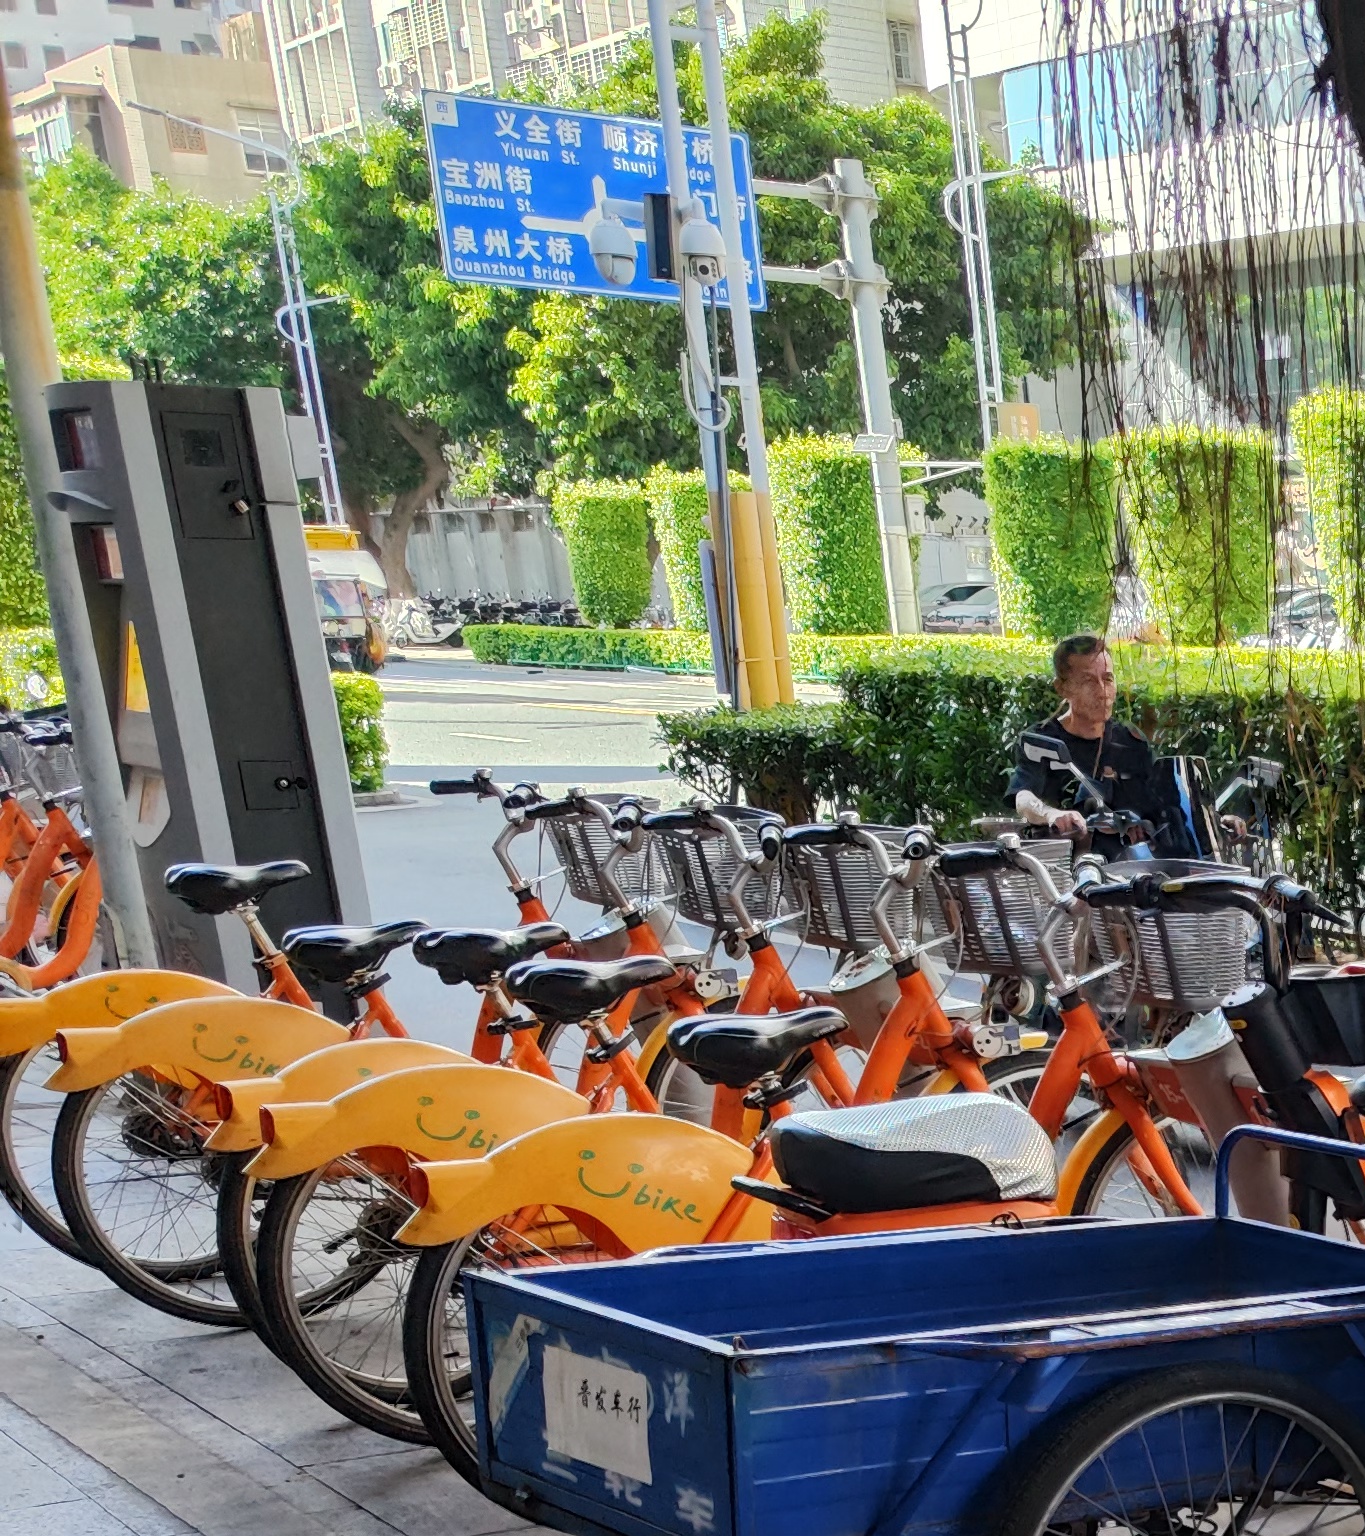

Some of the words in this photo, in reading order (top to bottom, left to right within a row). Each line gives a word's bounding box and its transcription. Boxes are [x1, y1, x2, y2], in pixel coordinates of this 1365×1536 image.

[435, 101, 448, 113] 西
[494, 110, 582, 148] 义全街
[501, 142, 549, 162] Yiquan
[561, 150, 580, 166] St.
[602, 123, 714, 166] 顺济桥
[441, 157, 533, 195] 宝洲街
[612, 156, 657, 179] Shunji
[444, 188, 505, 210] Baozhou
[516, 197, 535, 213] St.
[452, 225, 574, 266] 泉州大桥
[454, 257, 526, 278] Quanzhou
[532, 264, 576, 286] Bridge
